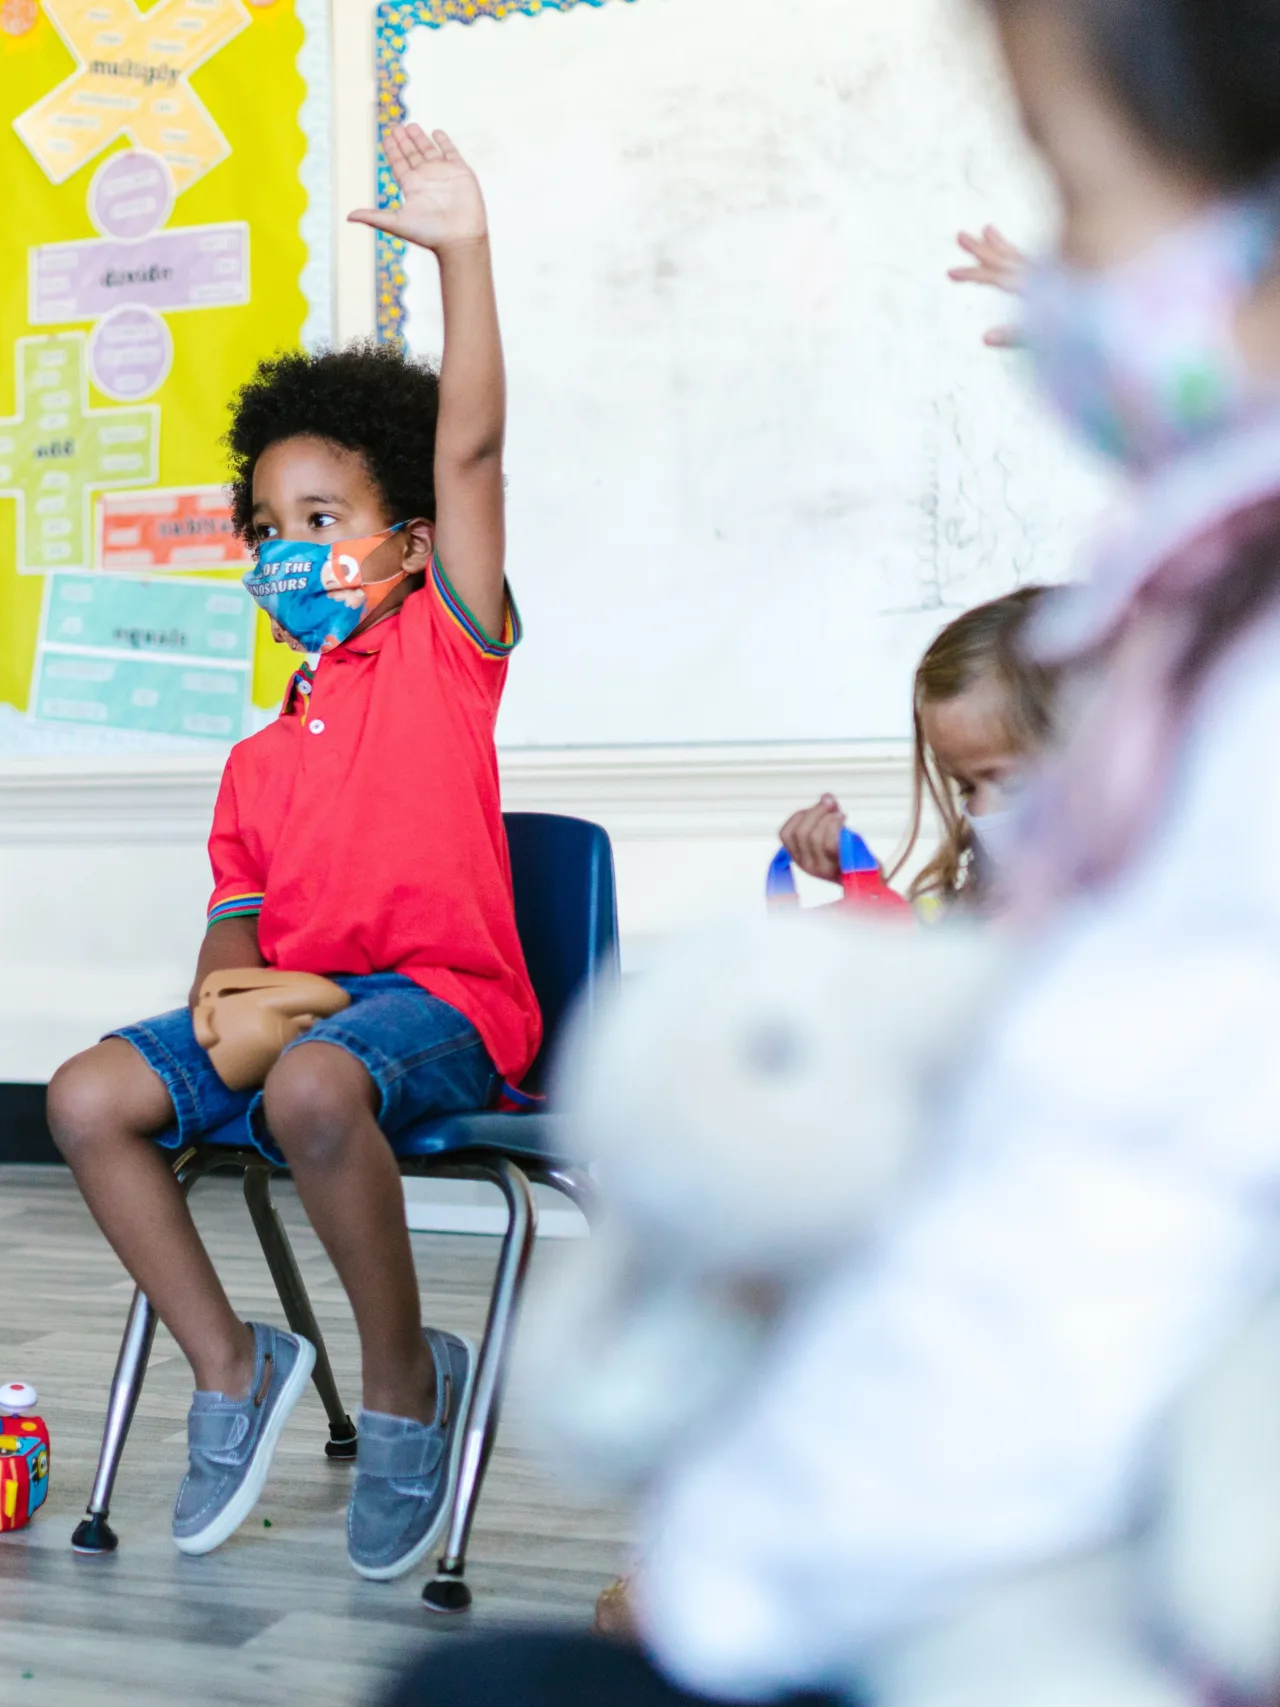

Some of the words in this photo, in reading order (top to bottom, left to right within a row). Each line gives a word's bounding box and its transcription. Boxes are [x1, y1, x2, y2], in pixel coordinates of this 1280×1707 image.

[89, 57, 182, 88] multiply
[99, 263, 174, 288] divide
[33, 437, 75, 458] add
[263, 562, 281, 577] OF
[284, 561, 312, 574] THE
[246, 576, 308, 597] INOSAURS
[112, 625, 189, 649] equals
